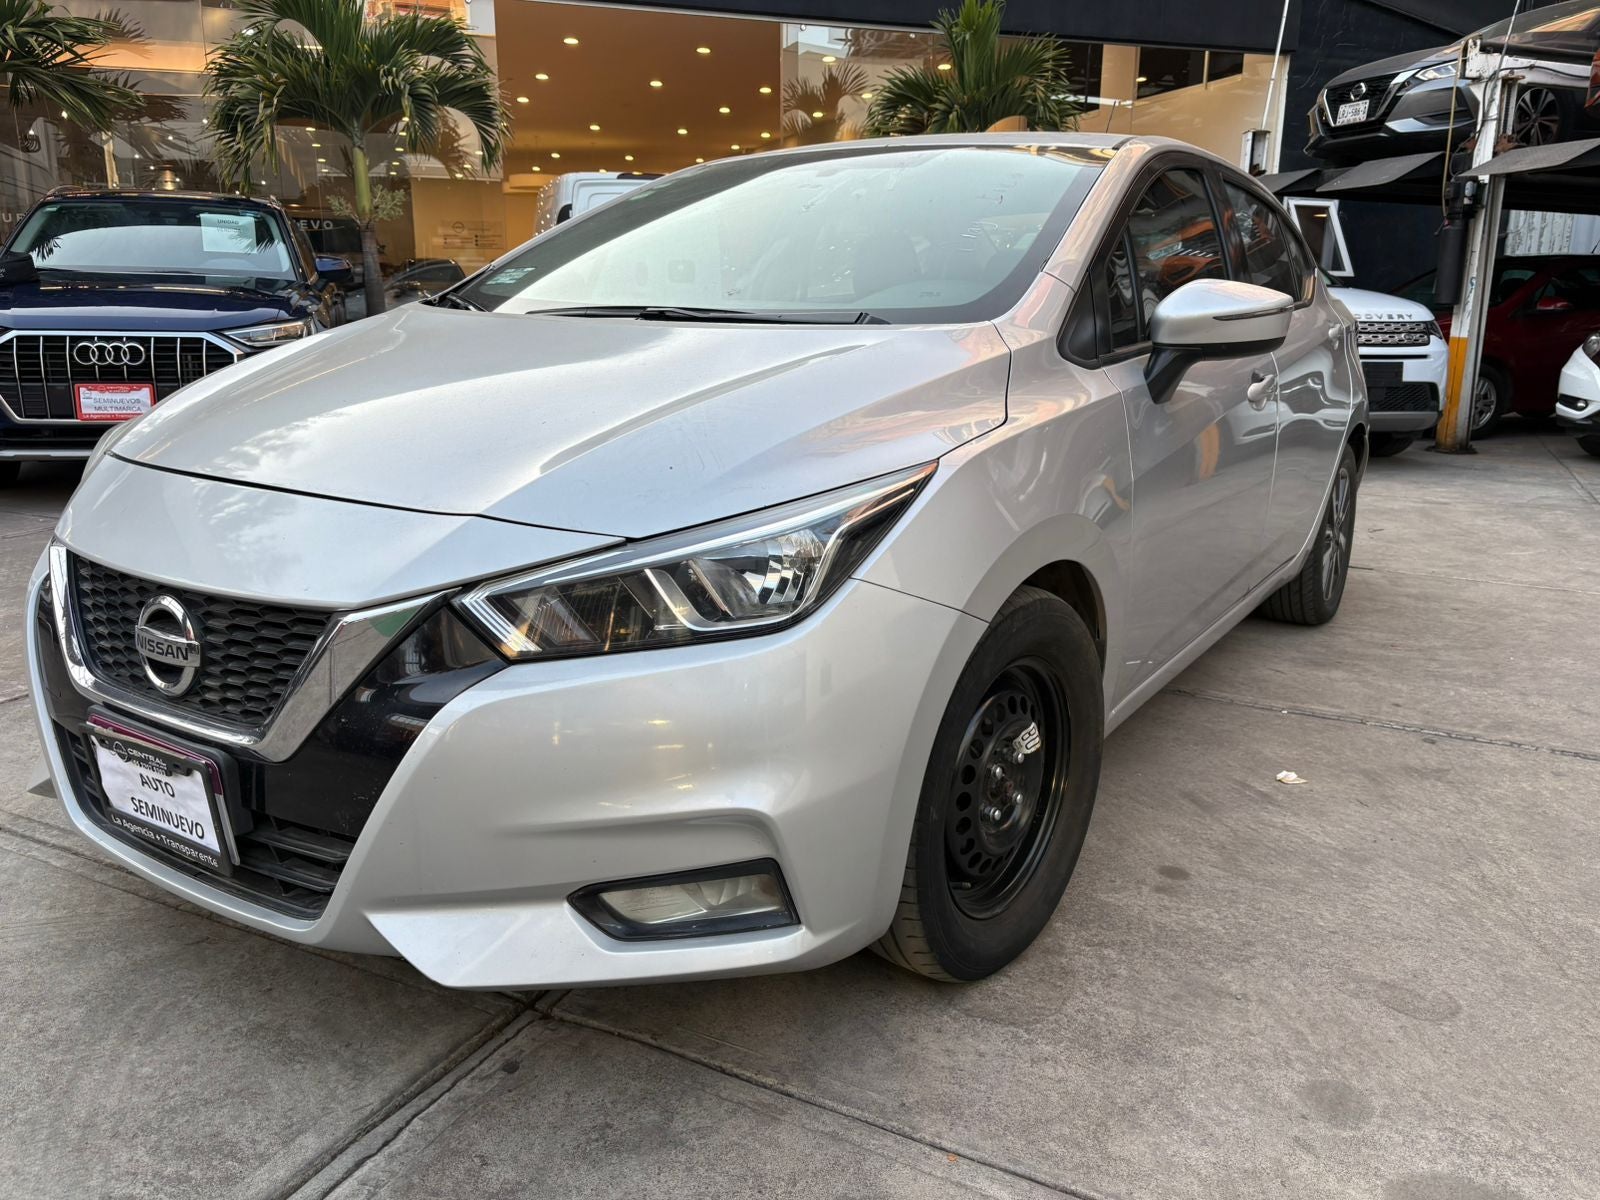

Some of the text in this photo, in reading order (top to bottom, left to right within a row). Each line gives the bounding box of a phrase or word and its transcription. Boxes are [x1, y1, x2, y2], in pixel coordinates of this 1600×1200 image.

[300, 219, 333, 230] EVO
[136, 632, 189, 661] NISSAN
[127, 748, 167, 766] CENTRAL
[139, 773, 175, 798] AUTO
[130, 796, 205, 840] SEMINUEVO
[111, 814, 122, 825] La
[122, 819, 155, 840] Agencia
[161, 834, 219, 868] Transparente
